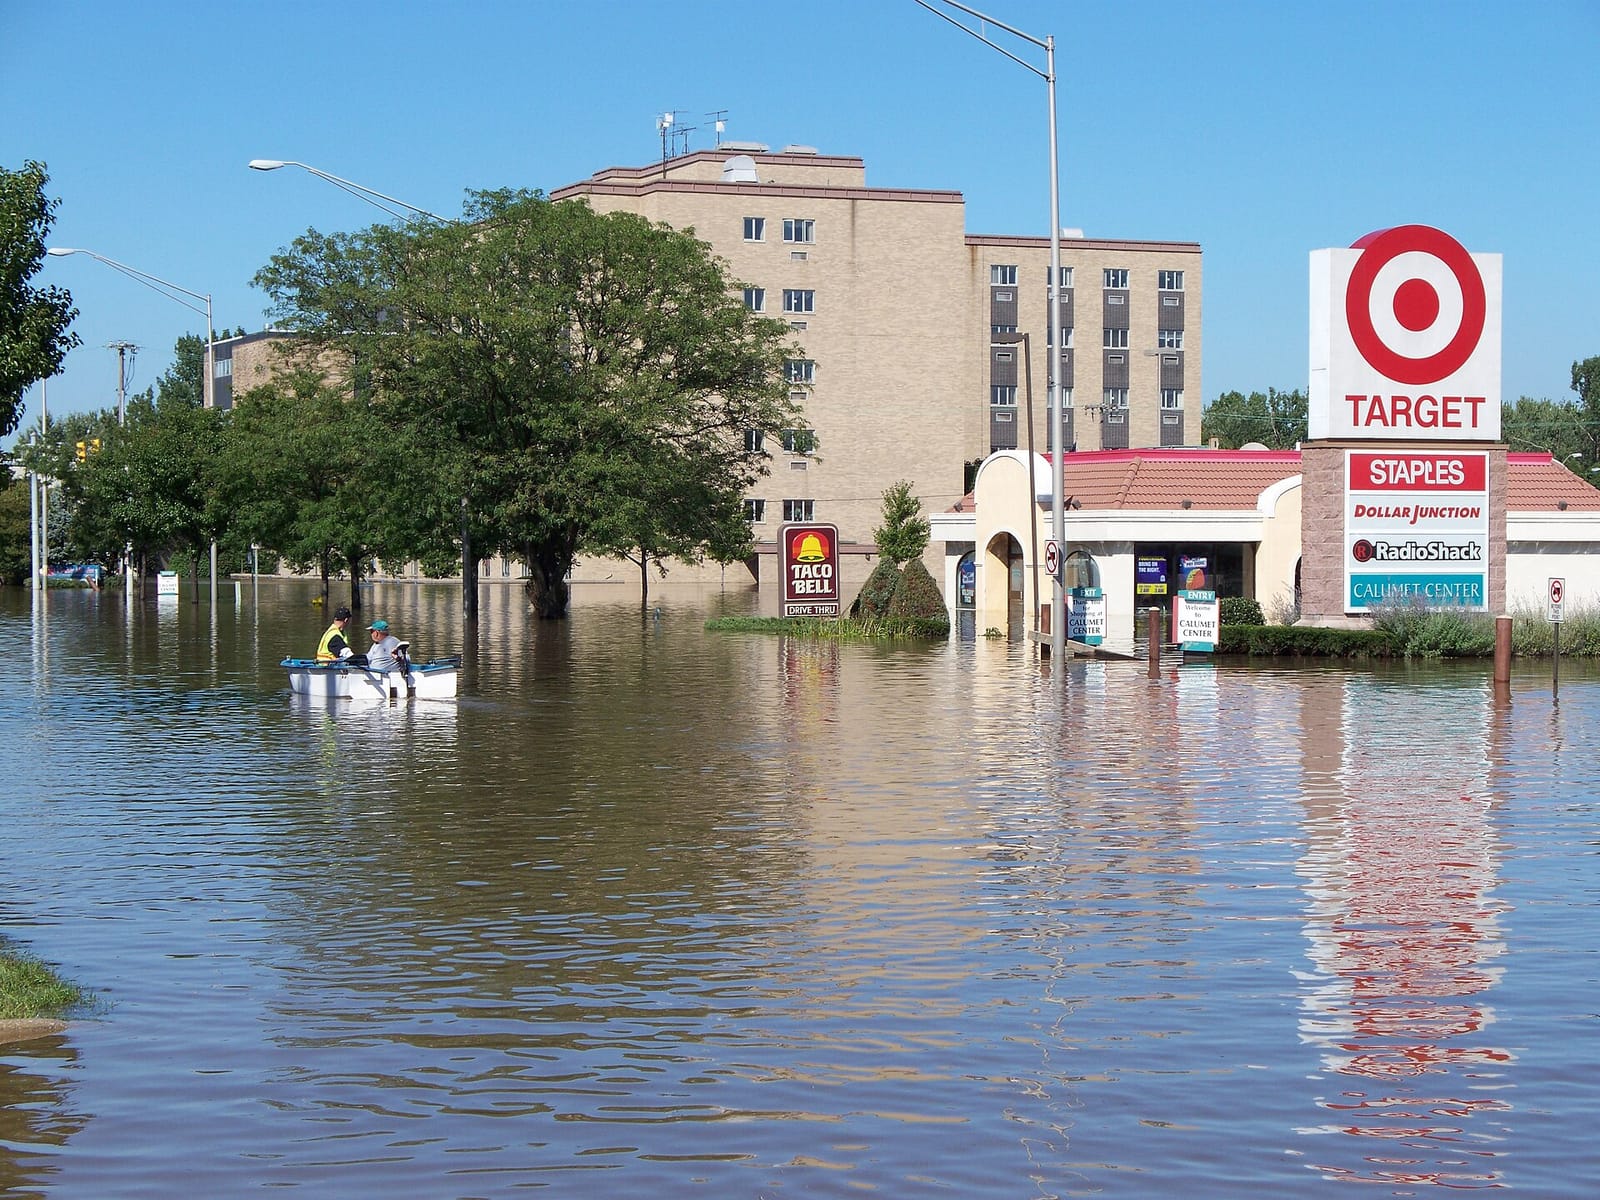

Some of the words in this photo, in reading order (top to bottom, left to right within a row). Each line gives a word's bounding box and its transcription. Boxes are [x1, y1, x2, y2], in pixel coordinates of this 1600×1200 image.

[1345, 395, 1486, 428] TARGET
[1370, 459, 1465, 485] STAPLES
[1354, 504, 1411, 518] DOLLAR
[1409, 505, 1481, 525] JUNCTION
[1375, 541, 1481, 561] RadioShack
[791, 564, 833, 579] TACO
[791, 579, 833, 594] BELL
[1080, 590, 1097, 598] EXIT
[1425, 583, 1480, 598] CENTER
[1187, 591, 1214, 600] ENTRY
[789, 606, 813, 615] DRIVE
[814, 606, 836, 614] THRU
[1072, 627, 1101, 635] CENTER
[1179, 620, 1216, 628] CALUMET
[1182, 629, 1212, 638] CENTER
